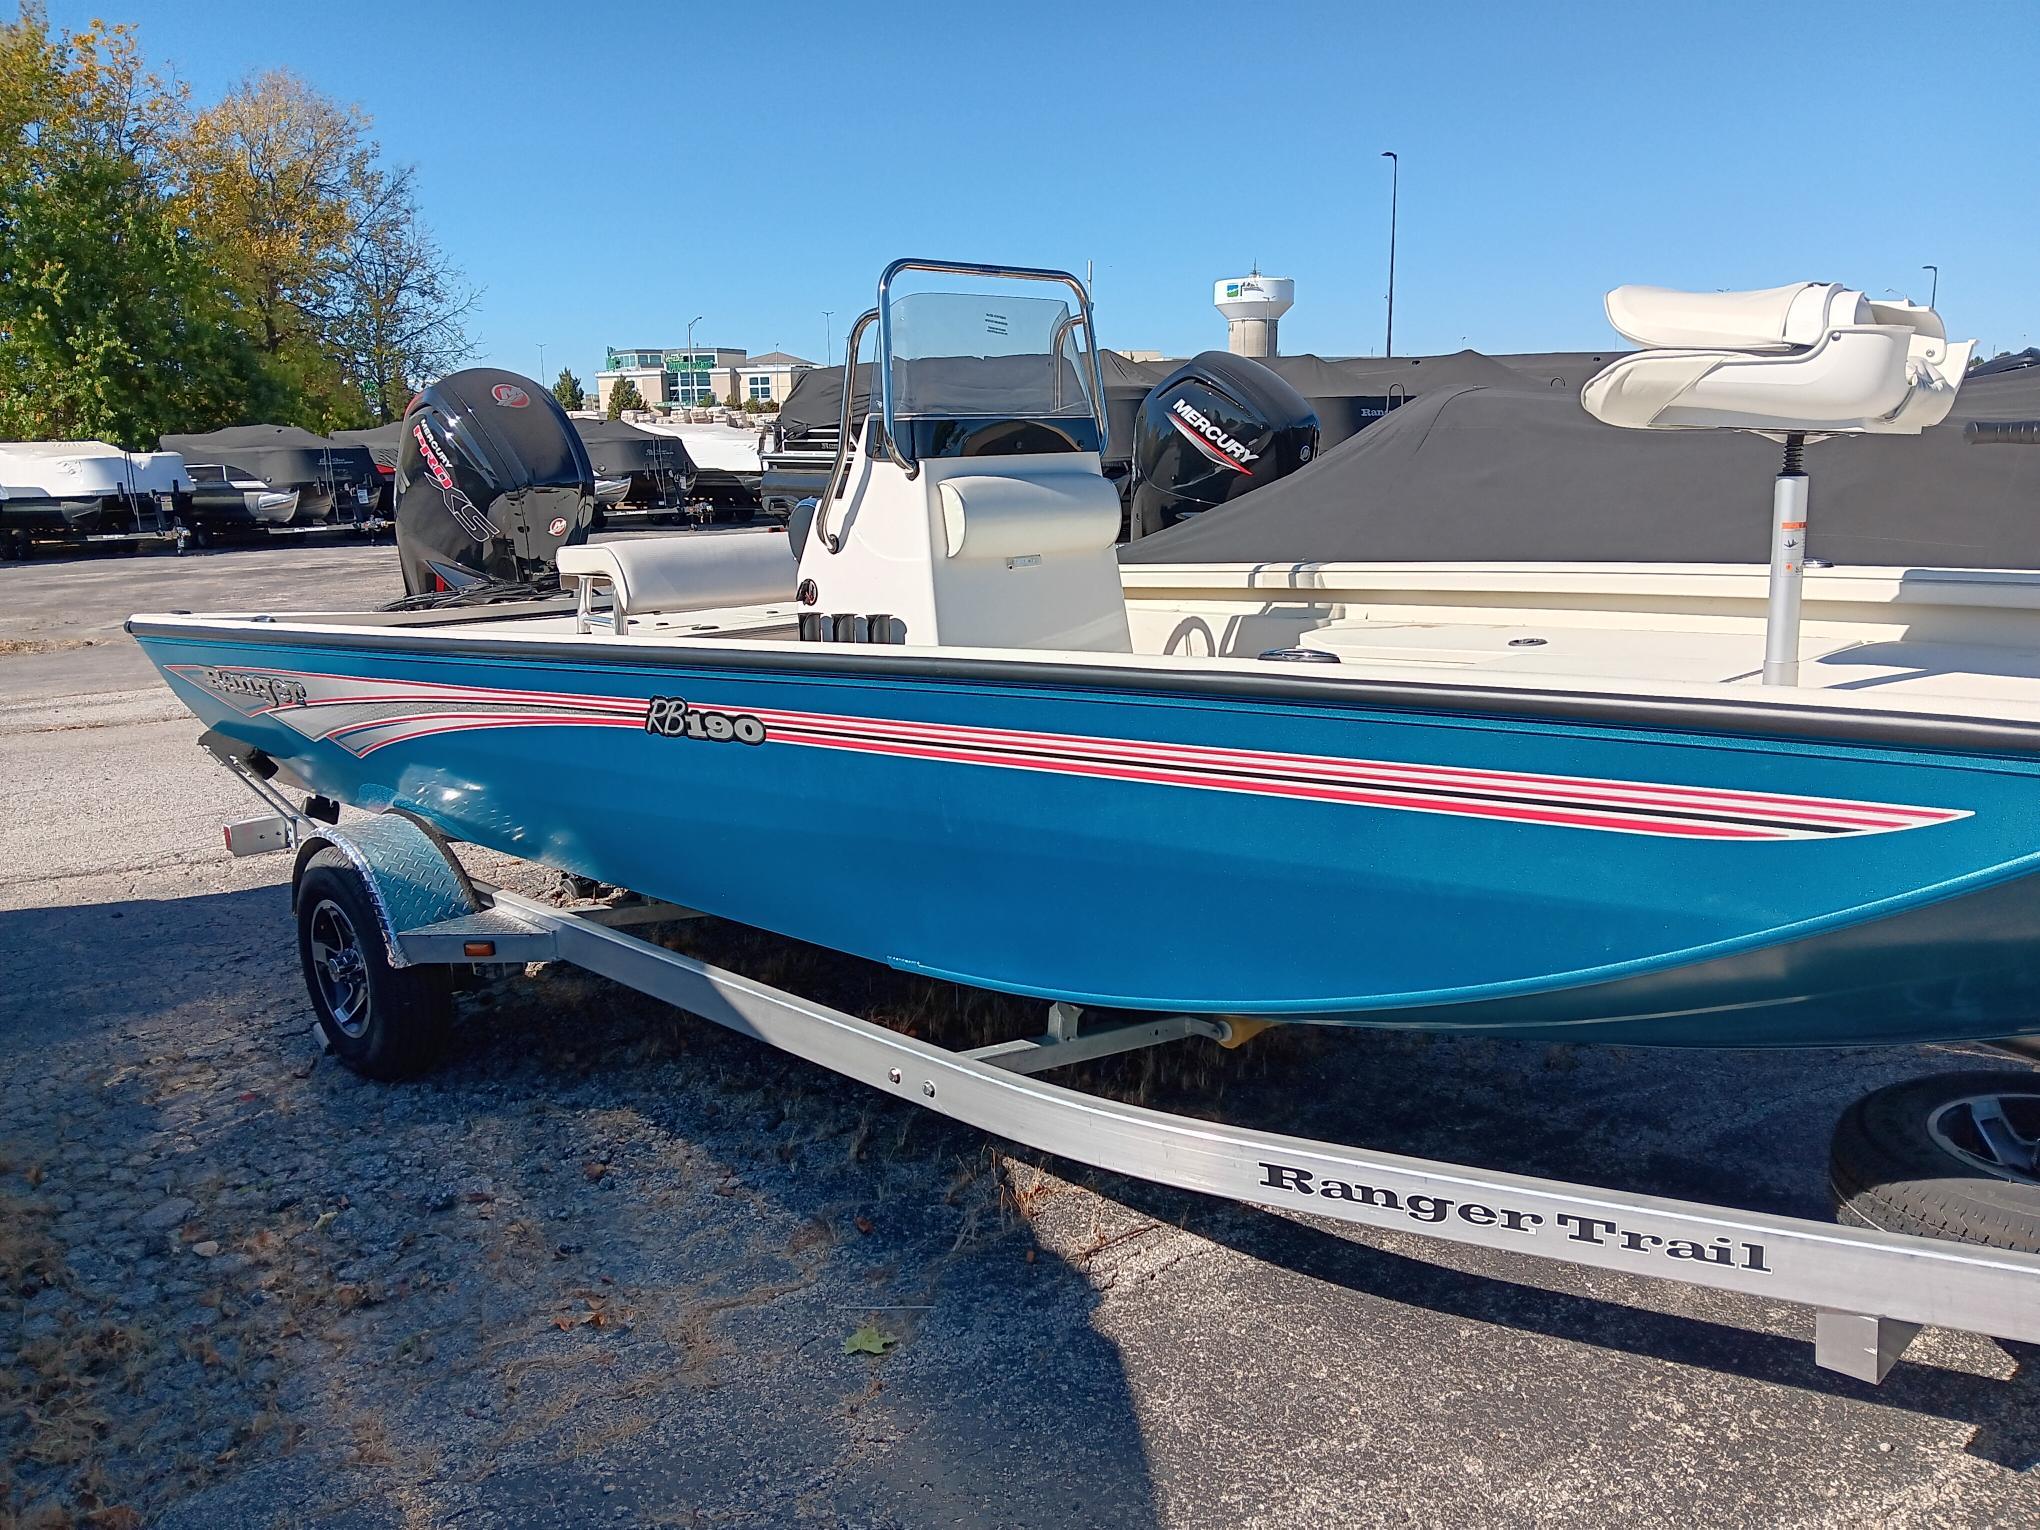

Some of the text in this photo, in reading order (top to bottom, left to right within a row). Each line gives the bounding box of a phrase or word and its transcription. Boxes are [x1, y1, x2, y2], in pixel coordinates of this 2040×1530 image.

[420, 419, 453, 468] MERCURY
[1172, 398, 1259, 463] MERCURY
[413, 425, 500, 542] PRO XS
[204, 668, 307, 708] Ranger
[1257, 1161, 1773, 1274] Ranger Trail
